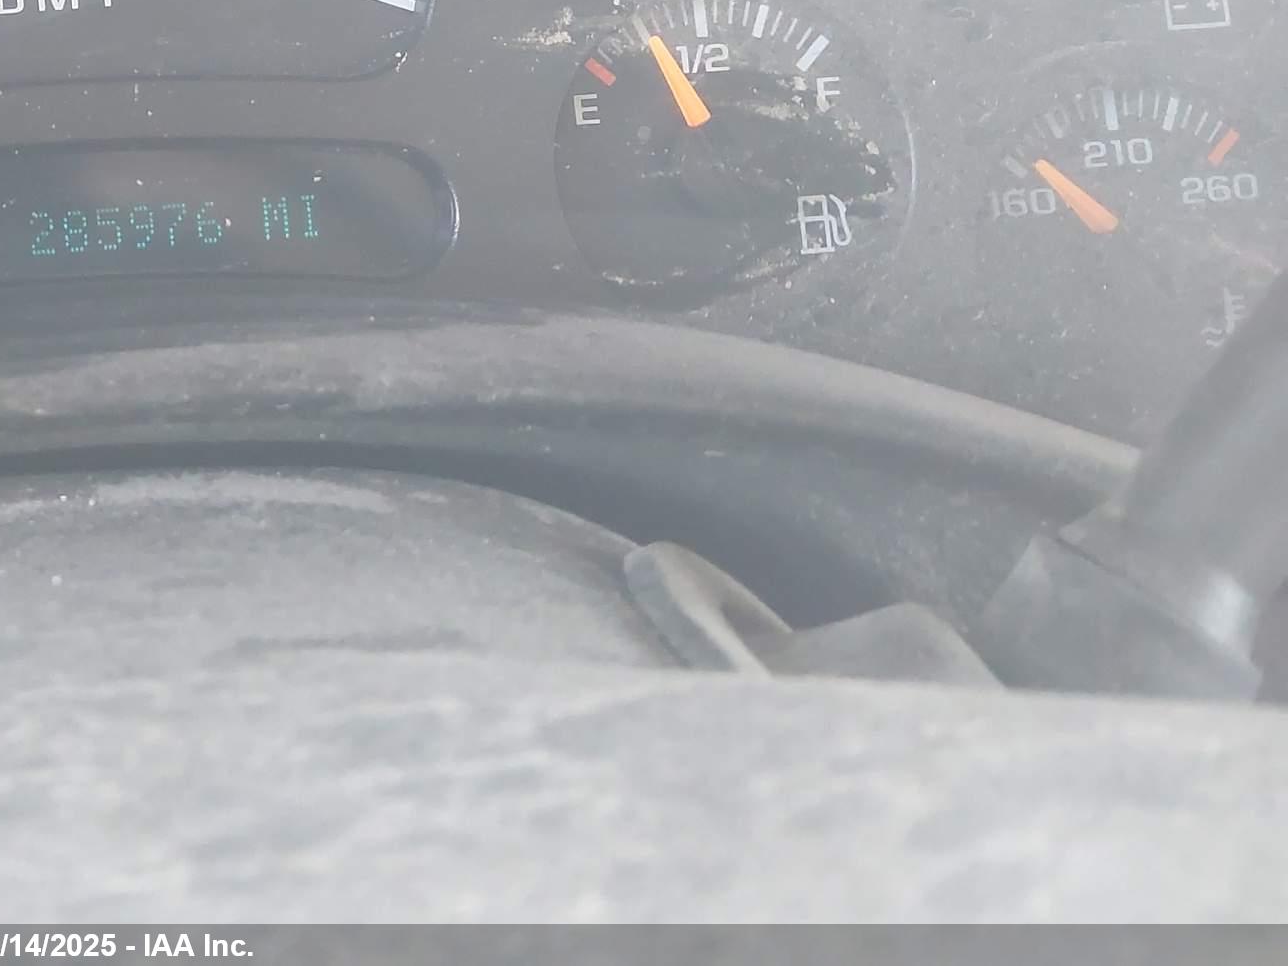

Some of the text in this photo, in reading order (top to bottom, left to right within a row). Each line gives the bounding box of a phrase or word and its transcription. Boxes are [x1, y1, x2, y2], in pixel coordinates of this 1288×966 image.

[676, 43, 731, 74] 1/2
[573, 93, 600, 126] E
[816, 76, 840, 113] F
[1083, 137, 1153, 169] 210
[988, 187, 1056, 221] 160
[1180, 173, 1259, 205] 260
[30, 201, 223, 255] 285976
[263, 194, 319, 240] MI
